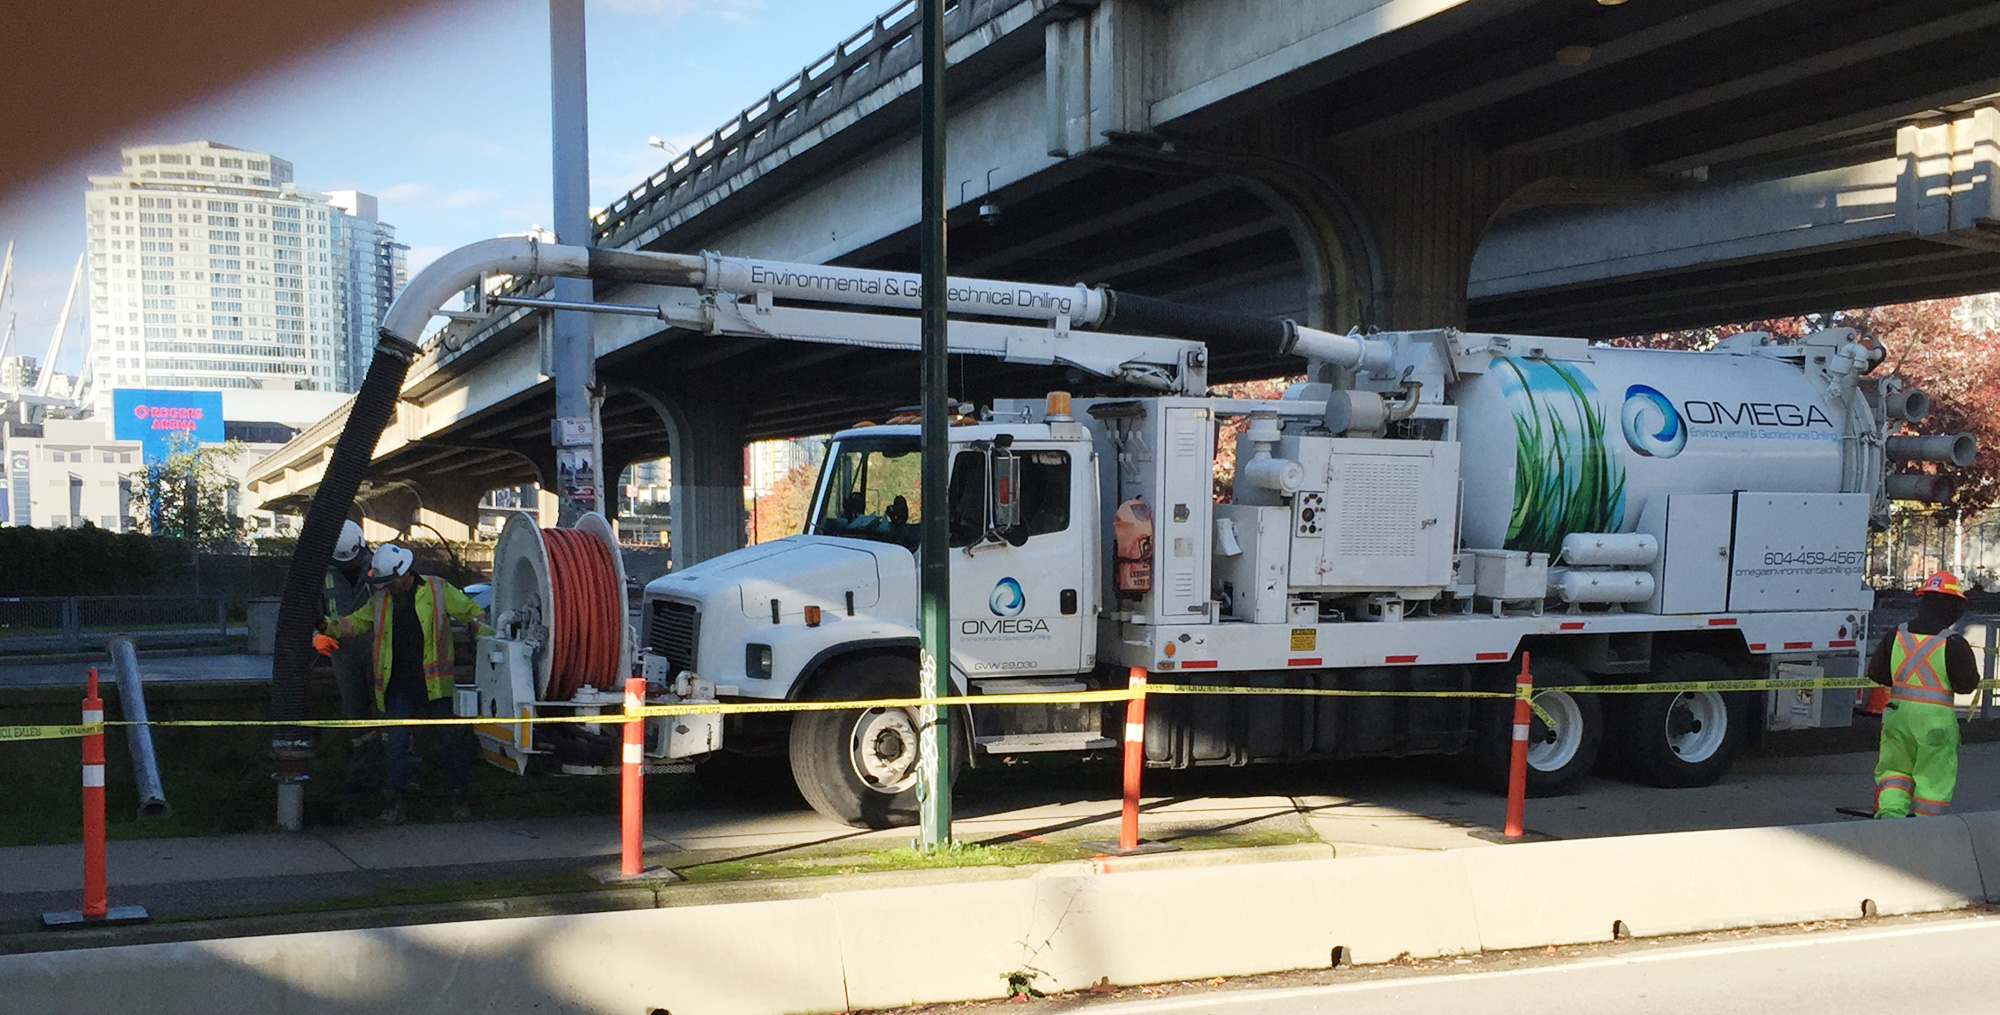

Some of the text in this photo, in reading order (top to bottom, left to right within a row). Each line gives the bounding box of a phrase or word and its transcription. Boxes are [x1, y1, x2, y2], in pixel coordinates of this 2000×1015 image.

[751, 265, 1071, 315] Environmental & Gechnical Drilling
[151, 406, 203, 419] ROGERS
[1684, 401, 1833, 428] OMEGA
[151, 419, 197, 430] ARENA
[1690, 428, 1749, 438] Environmental
[1764, 551, 1865, 565] 604-459-4567
[962, 619, 1050, 635] OMEGA
[974, 660, 1038, 671] GVW 29,030
